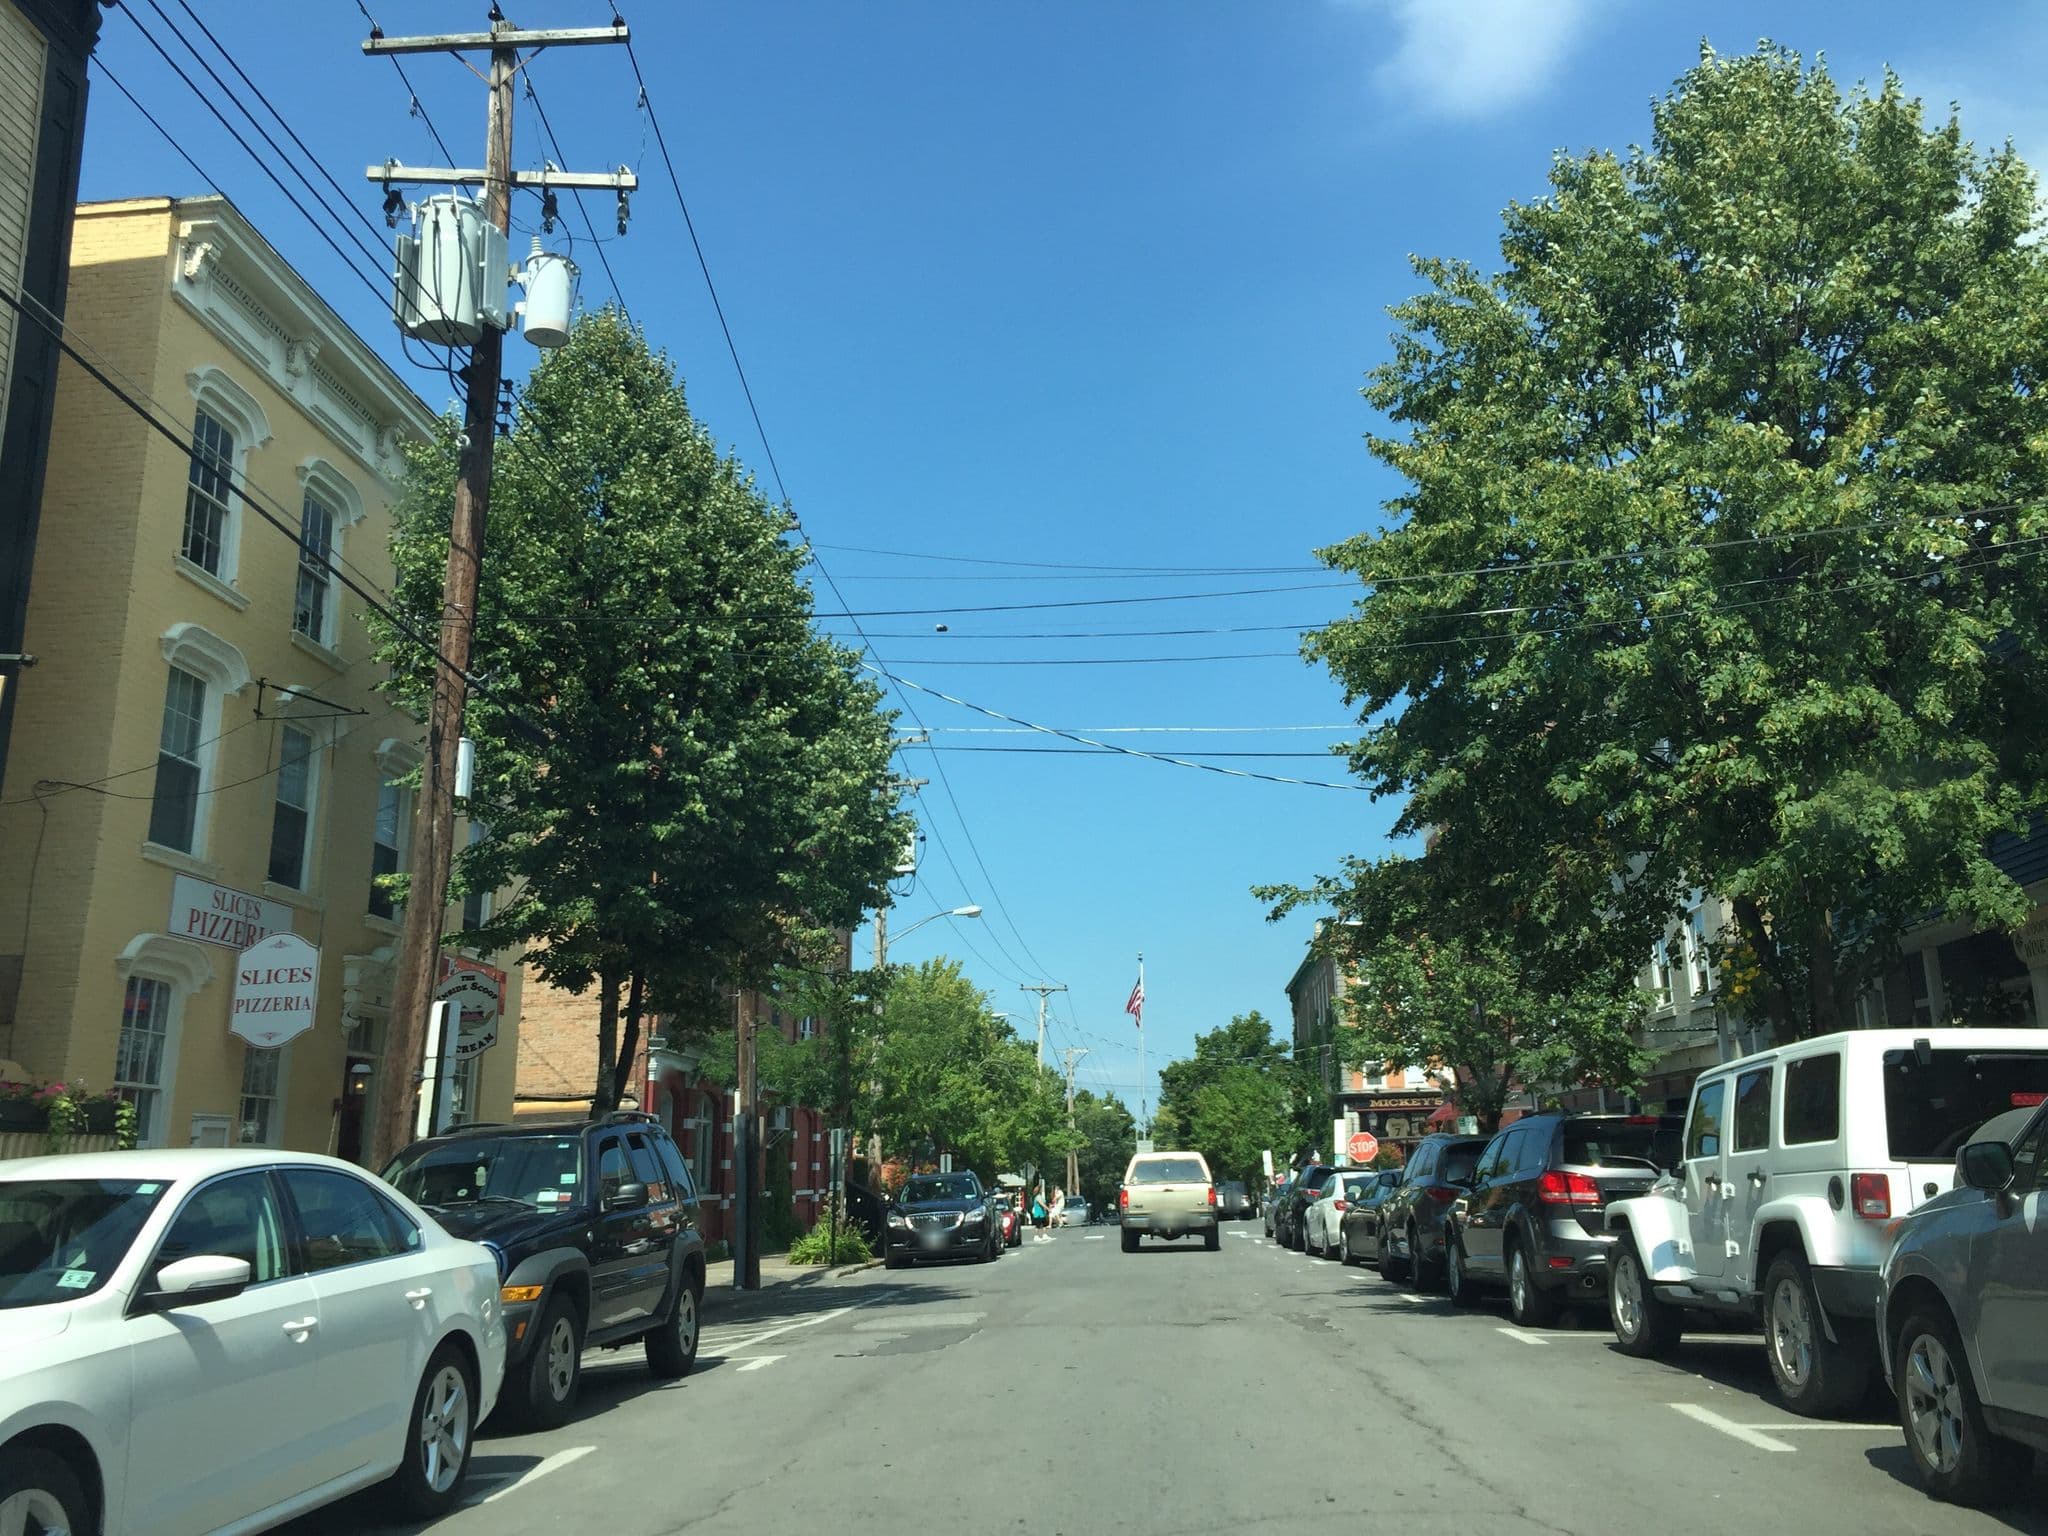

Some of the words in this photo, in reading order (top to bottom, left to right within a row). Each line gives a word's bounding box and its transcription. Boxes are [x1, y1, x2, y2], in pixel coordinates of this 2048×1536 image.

[212, 889, 261, 921] SLICES
[187, 908, 270, 947] PIZZERI
[240, 966, 312, 985] SLICES
[233, 996, 311, 1014] PIZZERIA
[1369, 1097, 1444, 1108] MICKEY'S
[1350, 1141, 1376, 1154] STOP
